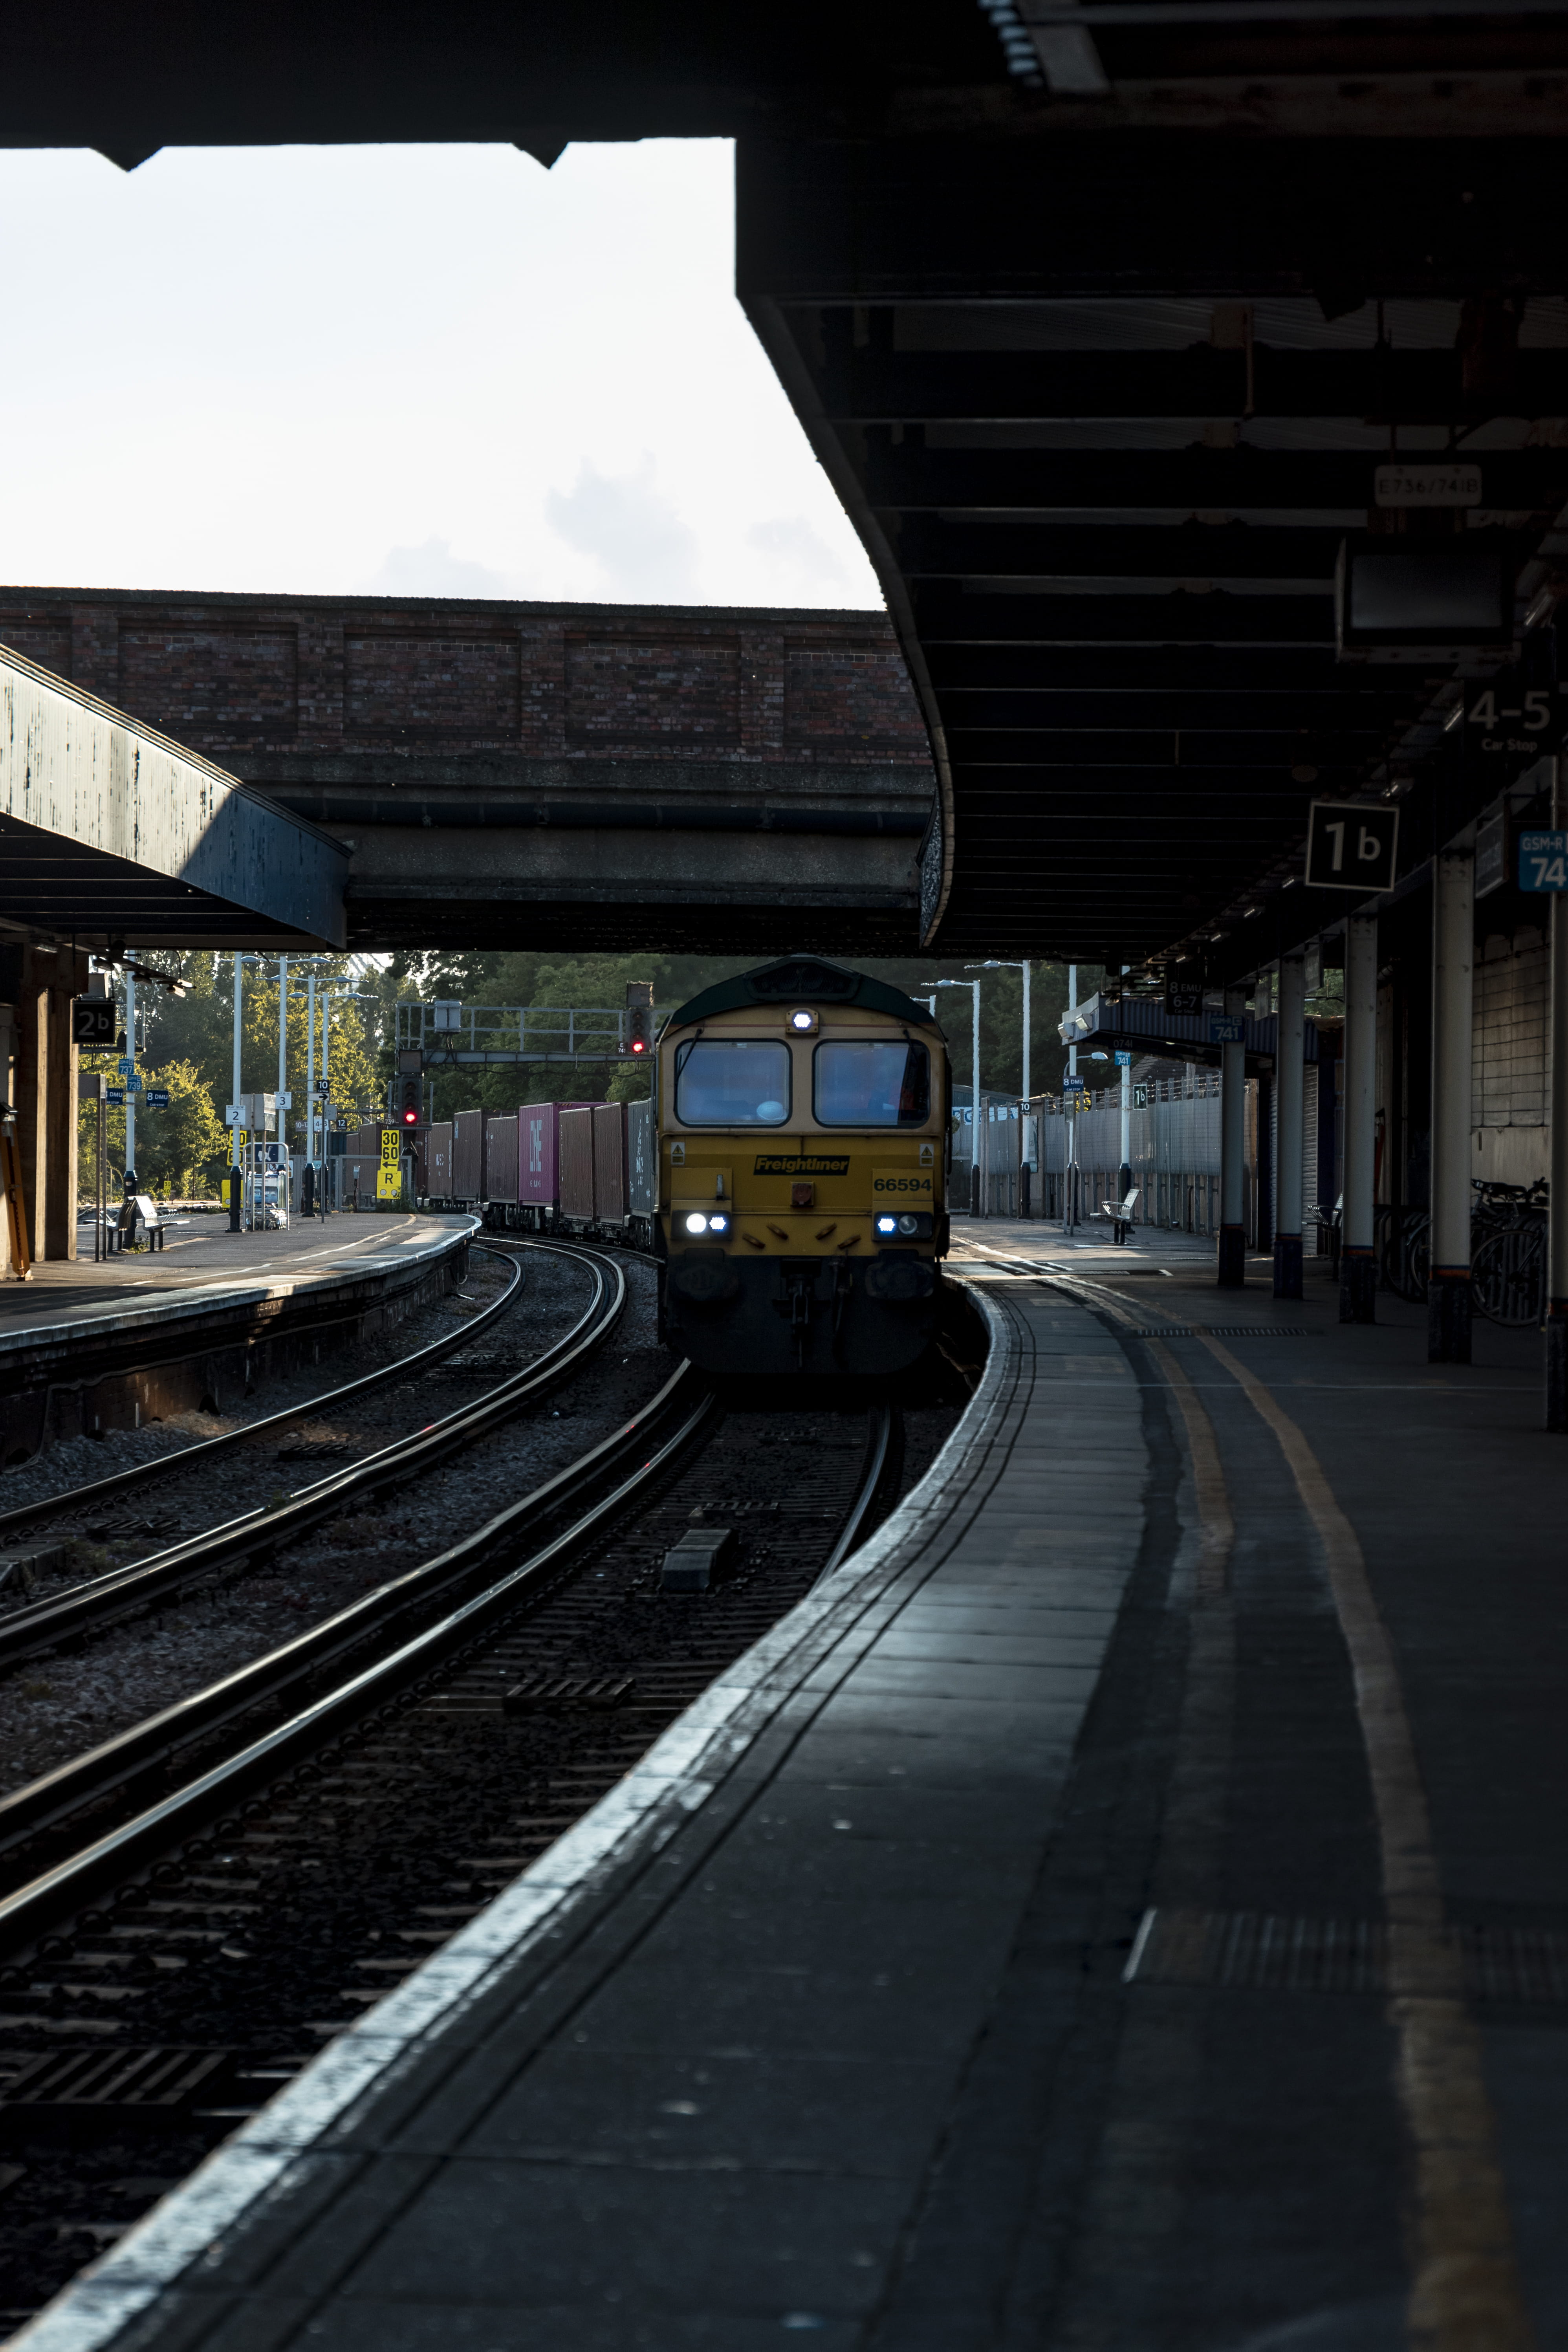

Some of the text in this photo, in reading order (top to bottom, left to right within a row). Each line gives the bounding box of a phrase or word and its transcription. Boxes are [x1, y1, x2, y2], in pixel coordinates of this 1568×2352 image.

[1467, 690, 1551, 731] 4-5
[1480, 737, 1539, 754] Car Stop
[1324, 821, 1381, 872] 1b
[1522, 836, 1564, 851] GSM-R
[1530, 857, 1568, 888] 74
[1169, 982, 1202, 994] 8 EMU
[1172, 995, 1197, 1008] 6-7
[78, 1011, 110, 1036] 2b
[1215, 1026, 1239, 1040] 741
[1112, 1039, 1133, 1048] 0741
[1117, 1057, 1128, 1065] 741
[119, 1065, 133, 1074] 737
[128, 1081, 141, 1090] 739
[147, 1092, 153, 1100] 8
[279, 1096, 286, 1105] 3
[1135, 1090, 1145, 1105] 1b
[233, 1111, 239, 1120] 2
[383, 1132, 397, 1145] 30
[383, 1147, 397, 1160] 60
[755, 1157, 848, 1173] Freightliner
[385, 1173, 393, 1184] R
[874, 1179, 932, 1192] 66594
